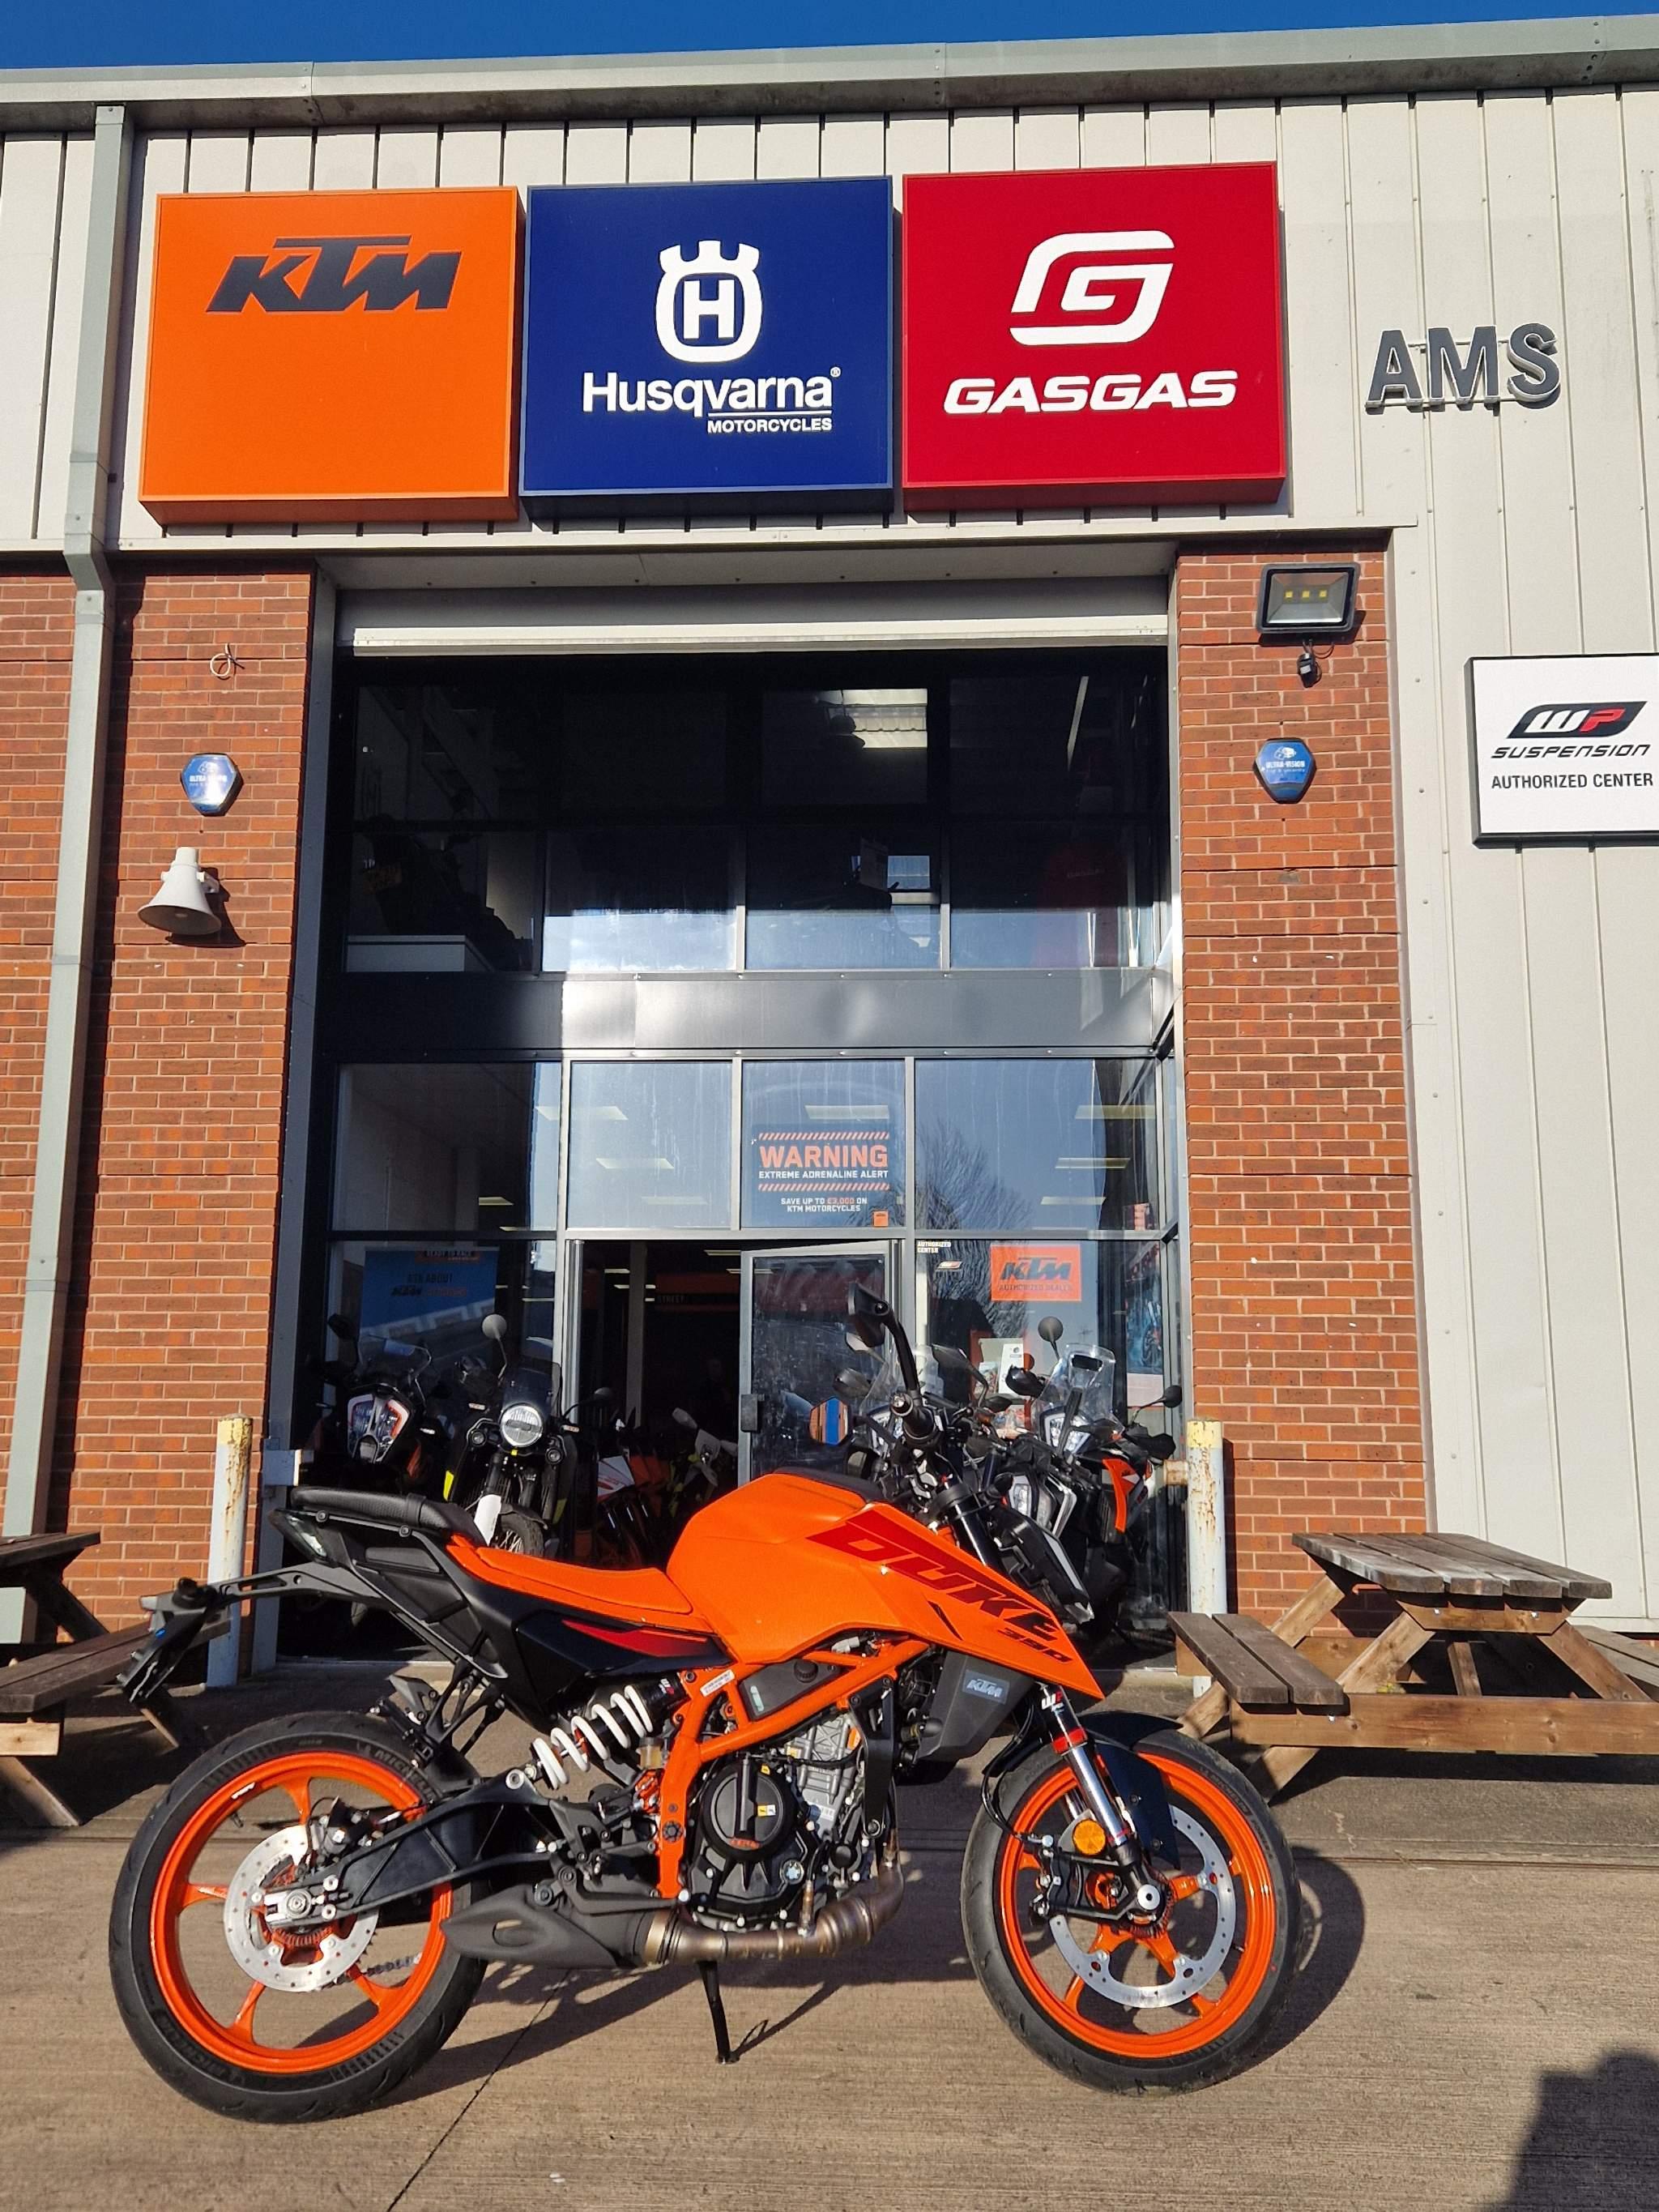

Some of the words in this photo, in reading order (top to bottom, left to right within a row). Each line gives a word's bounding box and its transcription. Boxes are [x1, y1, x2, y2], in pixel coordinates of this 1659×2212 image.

[206, 234, 463, 312] KTM
[1366, 323, 1560, 408] AMS
[944, 370, 1238, 414] GASGAS
[707, 416, 833, 434] MOTORCYCLES
[1521, 706, 1628, 734] WP
[1491, 744, 1652, 759] SUSPENSION
[1491, 775, 1588, 789] AUTHORIZED
[1593, 772, 1653, 788] CENTER
[759, 1144, 889, 1168] WARNING
[758, 1171, 800, 1179] EXTREME
[802, 1170, 857, 1179] ADRENALINE
[860, 1170, 889, 1178] ALERT
[1000, 1257, 1073, 1280] KTM
[999, 1283, 1043, 1292] AUTHORIZED
[805, 1523, 1059, 1642] DUKE
[997, 1627, 1073, 1663] 390
[966, 1678, 1003, 1698] KTM
